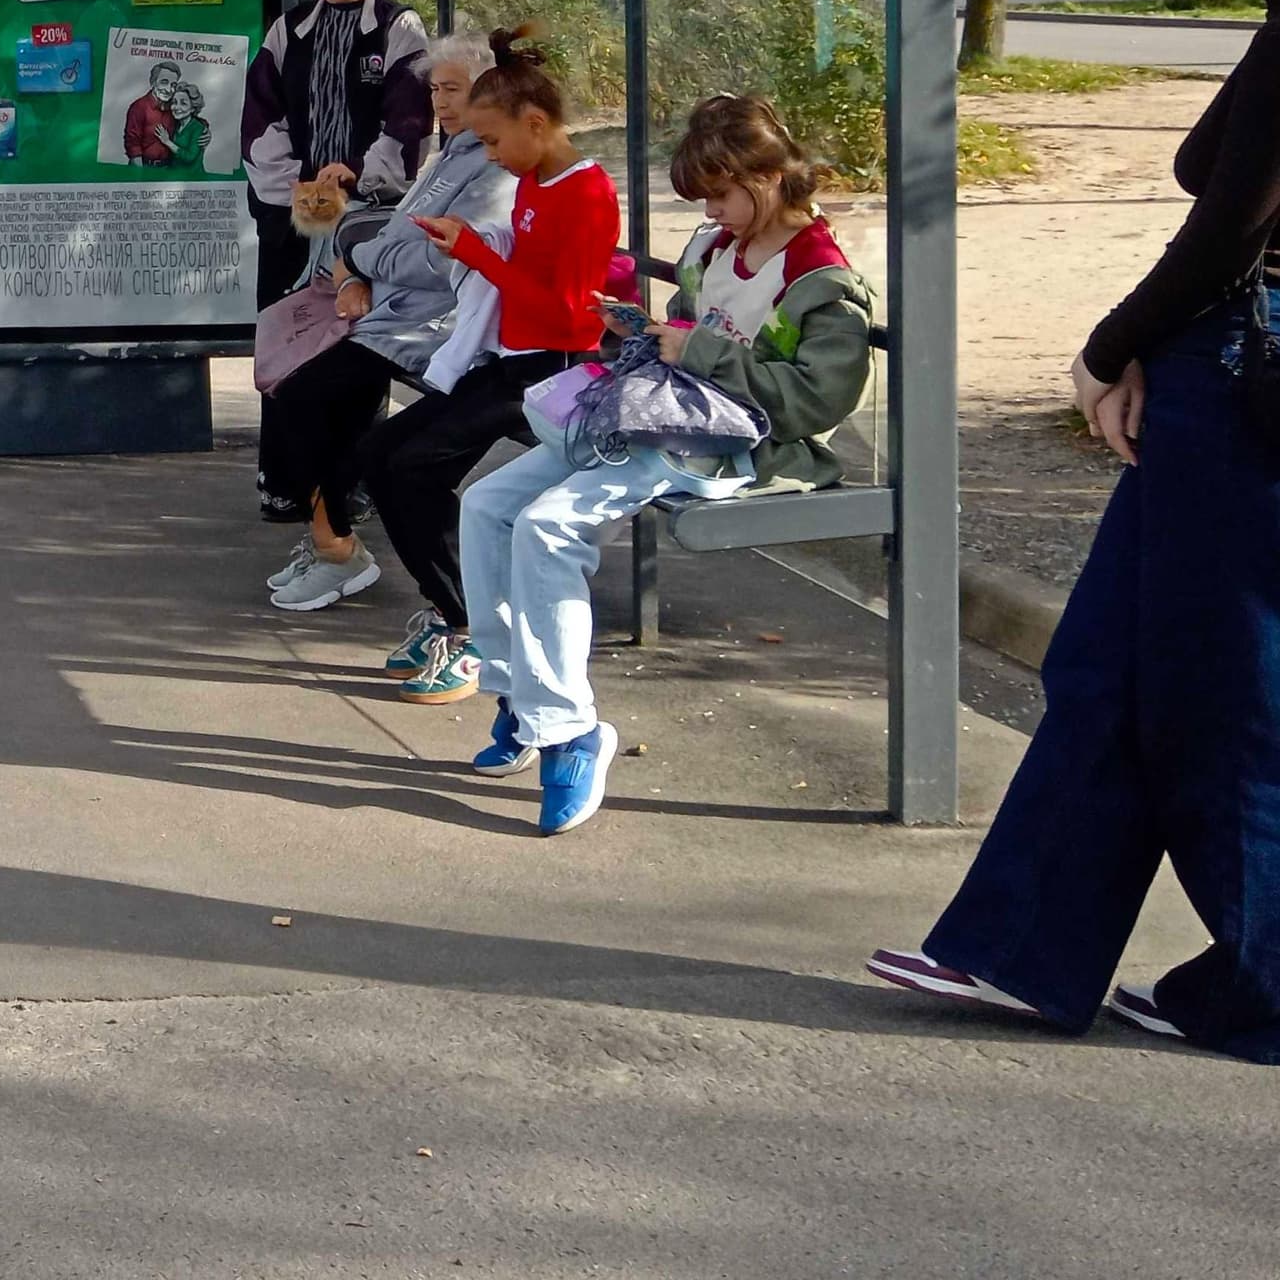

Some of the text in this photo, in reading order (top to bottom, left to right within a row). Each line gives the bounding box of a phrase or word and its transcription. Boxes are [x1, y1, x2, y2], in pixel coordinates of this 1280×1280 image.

[35, 27, 68, 43] -20%
[140, 241, 240, 269] НЕОБХОДИМО
[4, 270, 123, 298] КОНСУЛЬТАЦИИ
[132, 269, 240, 298] СПЕЦИАЛИСТА
